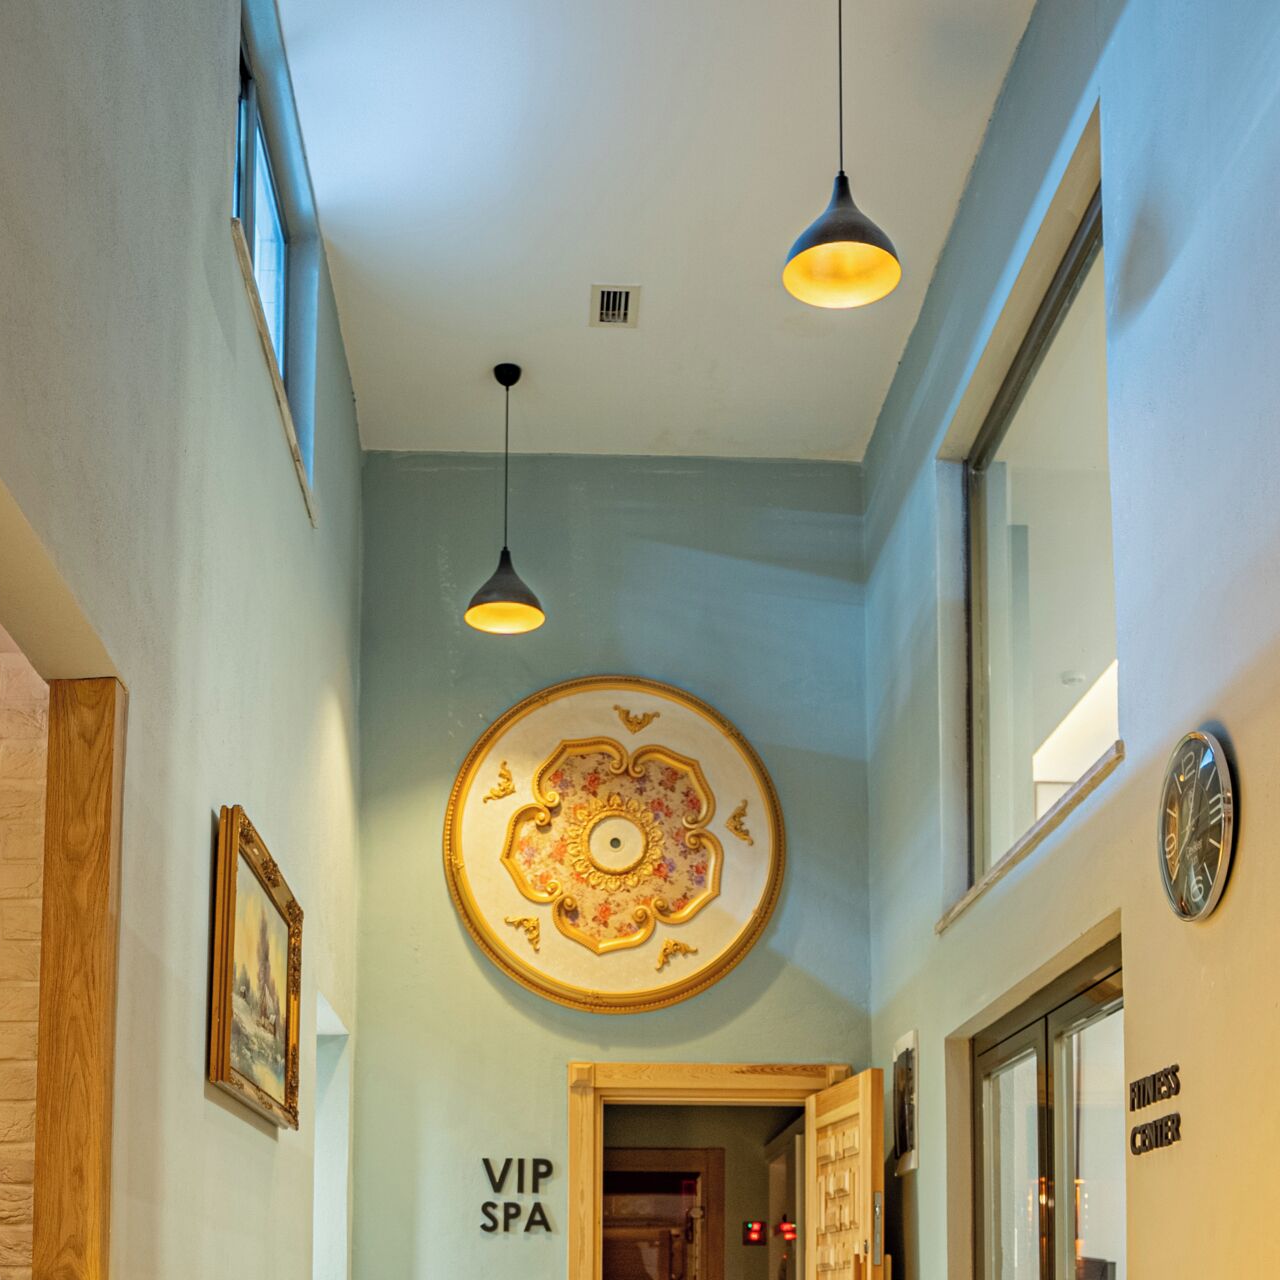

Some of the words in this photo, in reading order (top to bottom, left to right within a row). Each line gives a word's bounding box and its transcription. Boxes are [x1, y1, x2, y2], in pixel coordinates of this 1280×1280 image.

[1190, 876, 1205, 902] 6
[1129, 1065, 1180, 1112] FITNESS
[1130, 1113, 1181, 1155] CENTER
[482, 1158, 553, 1193] VIP
[480, 1201, 552, 1232] SPA
